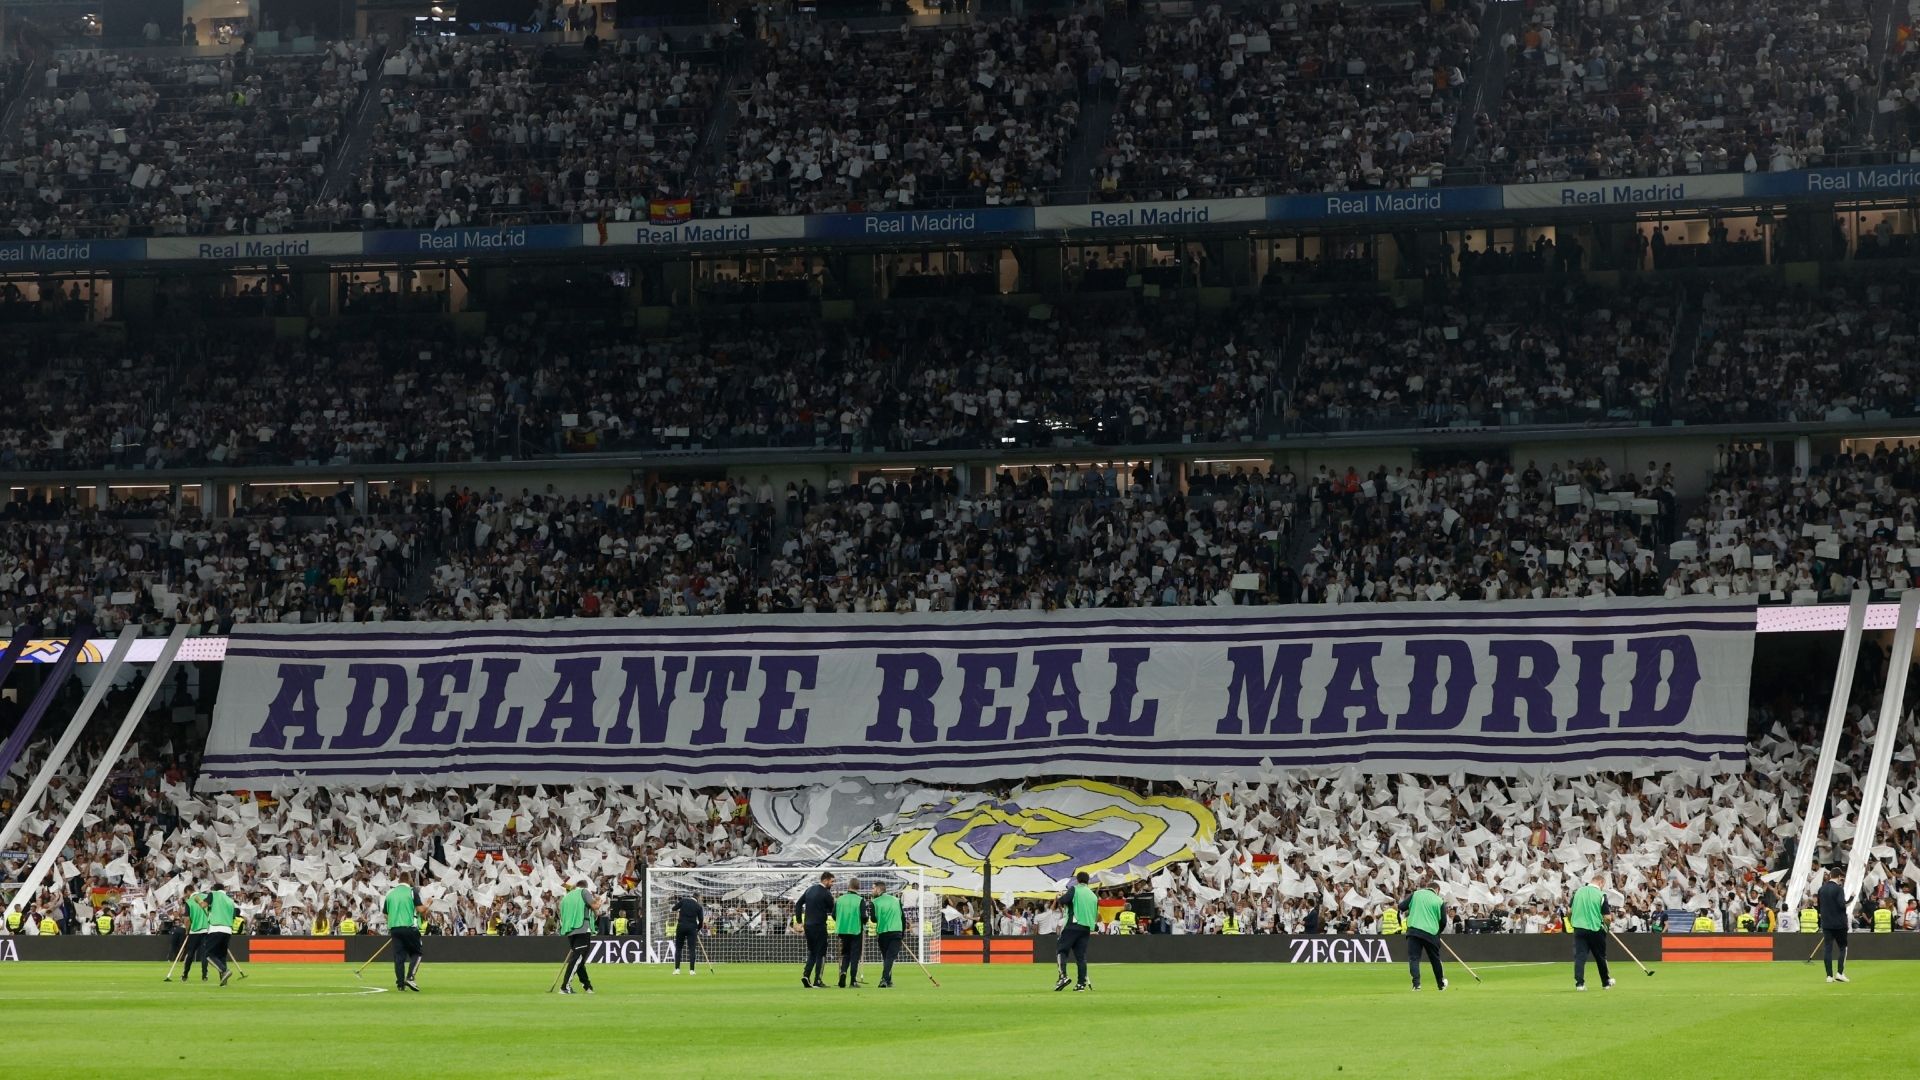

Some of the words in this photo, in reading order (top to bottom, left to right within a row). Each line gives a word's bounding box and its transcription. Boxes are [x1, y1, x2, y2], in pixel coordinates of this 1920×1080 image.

[1808, 172, 1851, 191] Real
[1327, 196, 1368, 214] Real
[1375, 193, 1441, 212] Madrid
[1561, 187, 1606, 205] Real
[1612, 183, 1684, 203] Madrid
[865, 216, 905, 233] Real
[911, 213, 975, 231] Madrid
[1091, 209, 1133, 227] Real
[1140, 206, 1209, 225] Madrid
[420, 232, 457, 249] Real
[464, 229, 525, 248] Madrid
[637, 227, 678, 244] Real
[684, 223, 750, 241] Madrid
[0, 244, 24, 261] eal
[30, 243, 90, 260] Madrid
[199, 242, 239, 258] Real
[245, 240, 309, 257] Madrid
[249, 655, 819, 751] ADELANTE
[865, 647, 1159, 743] REAL
[1216, 635, 1701, 735] MADRID
[1781, 919, 1789, 929] 2
[585, 939, 676, 964] ZEGNA
[1289, 938, 1393, 963] ZEGNA
